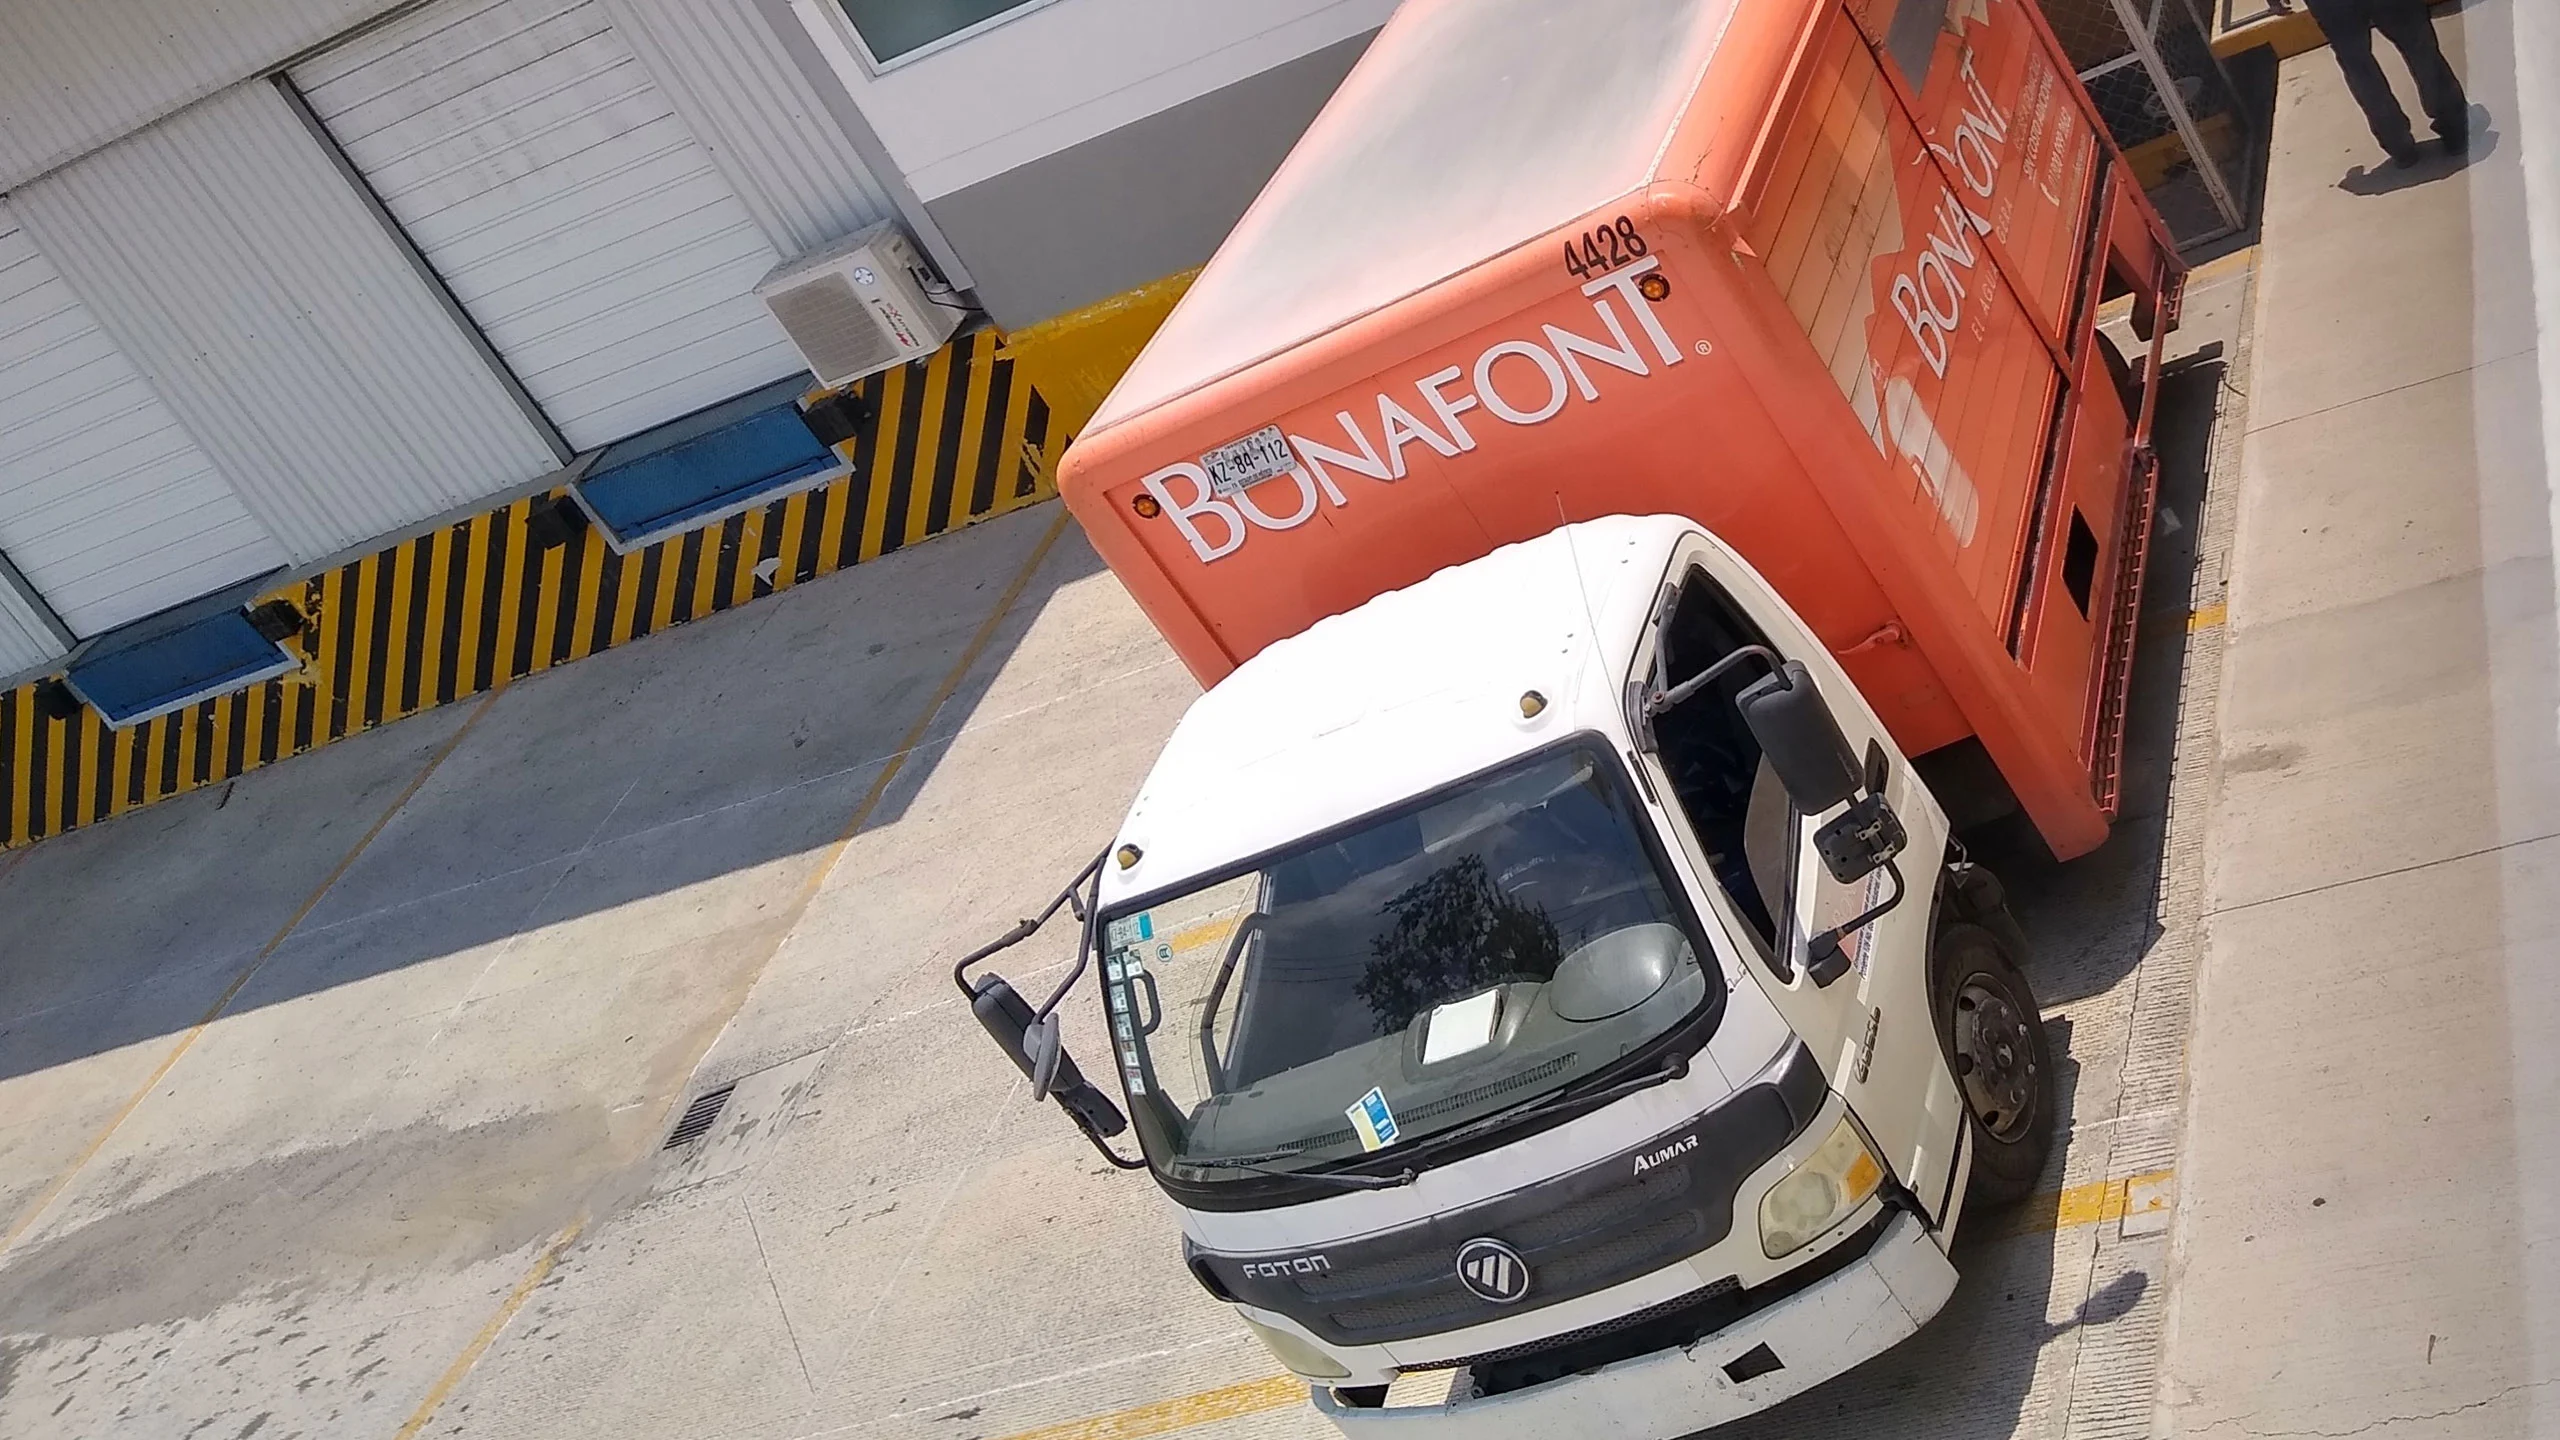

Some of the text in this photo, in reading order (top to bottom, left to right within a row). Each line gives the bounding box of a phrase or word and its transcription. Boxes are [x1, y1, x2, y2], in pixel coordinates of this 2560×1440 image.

[2027, 119, 2042, 158] COSTO
[1890, 46, 2007, 380] BONAONT
[1564, 215, 1647, 280] 4428
[1207, 439, 1288, 486] KZ-84-112
[1242, 1254, 1331, 1279] FOTON
